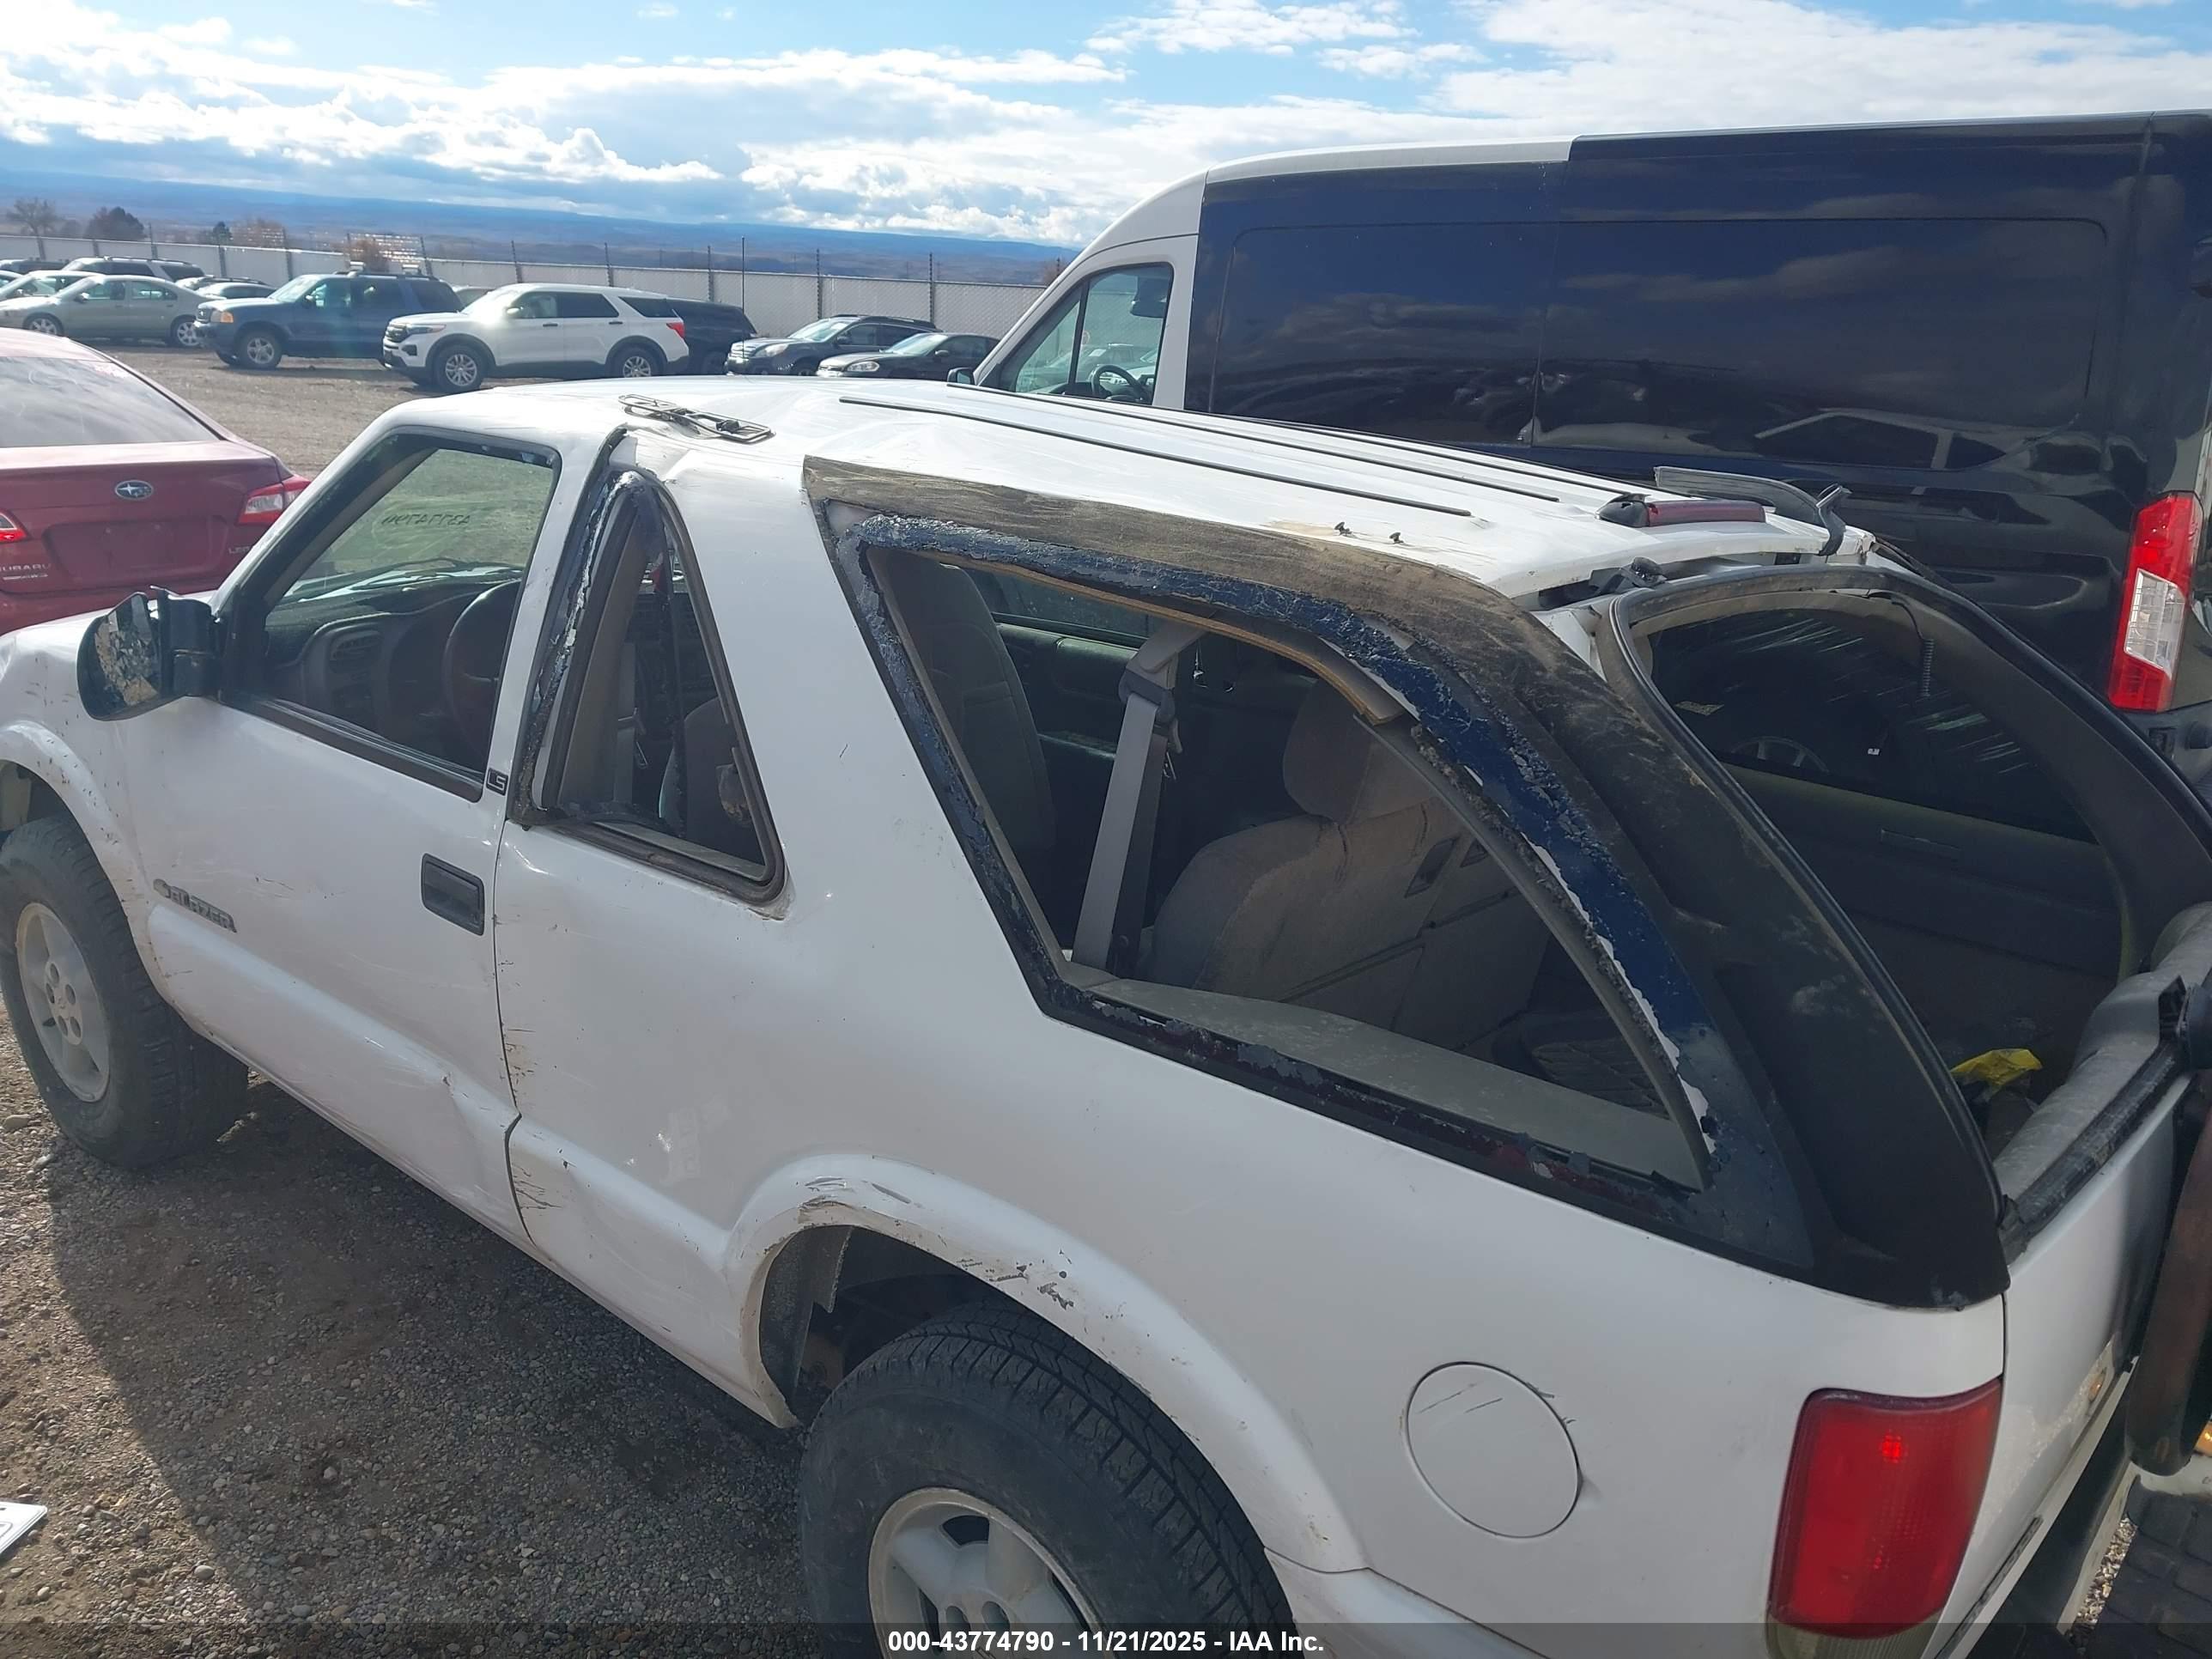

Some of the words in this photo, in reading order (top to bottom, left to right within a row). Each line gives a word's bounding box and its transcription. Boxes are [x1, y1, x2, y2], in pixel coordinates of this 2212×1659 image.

[0, 563, 51, 572] UBARU
[487, 770, 507, 791] LS
[170, 885, 235, 932] BLAZER
